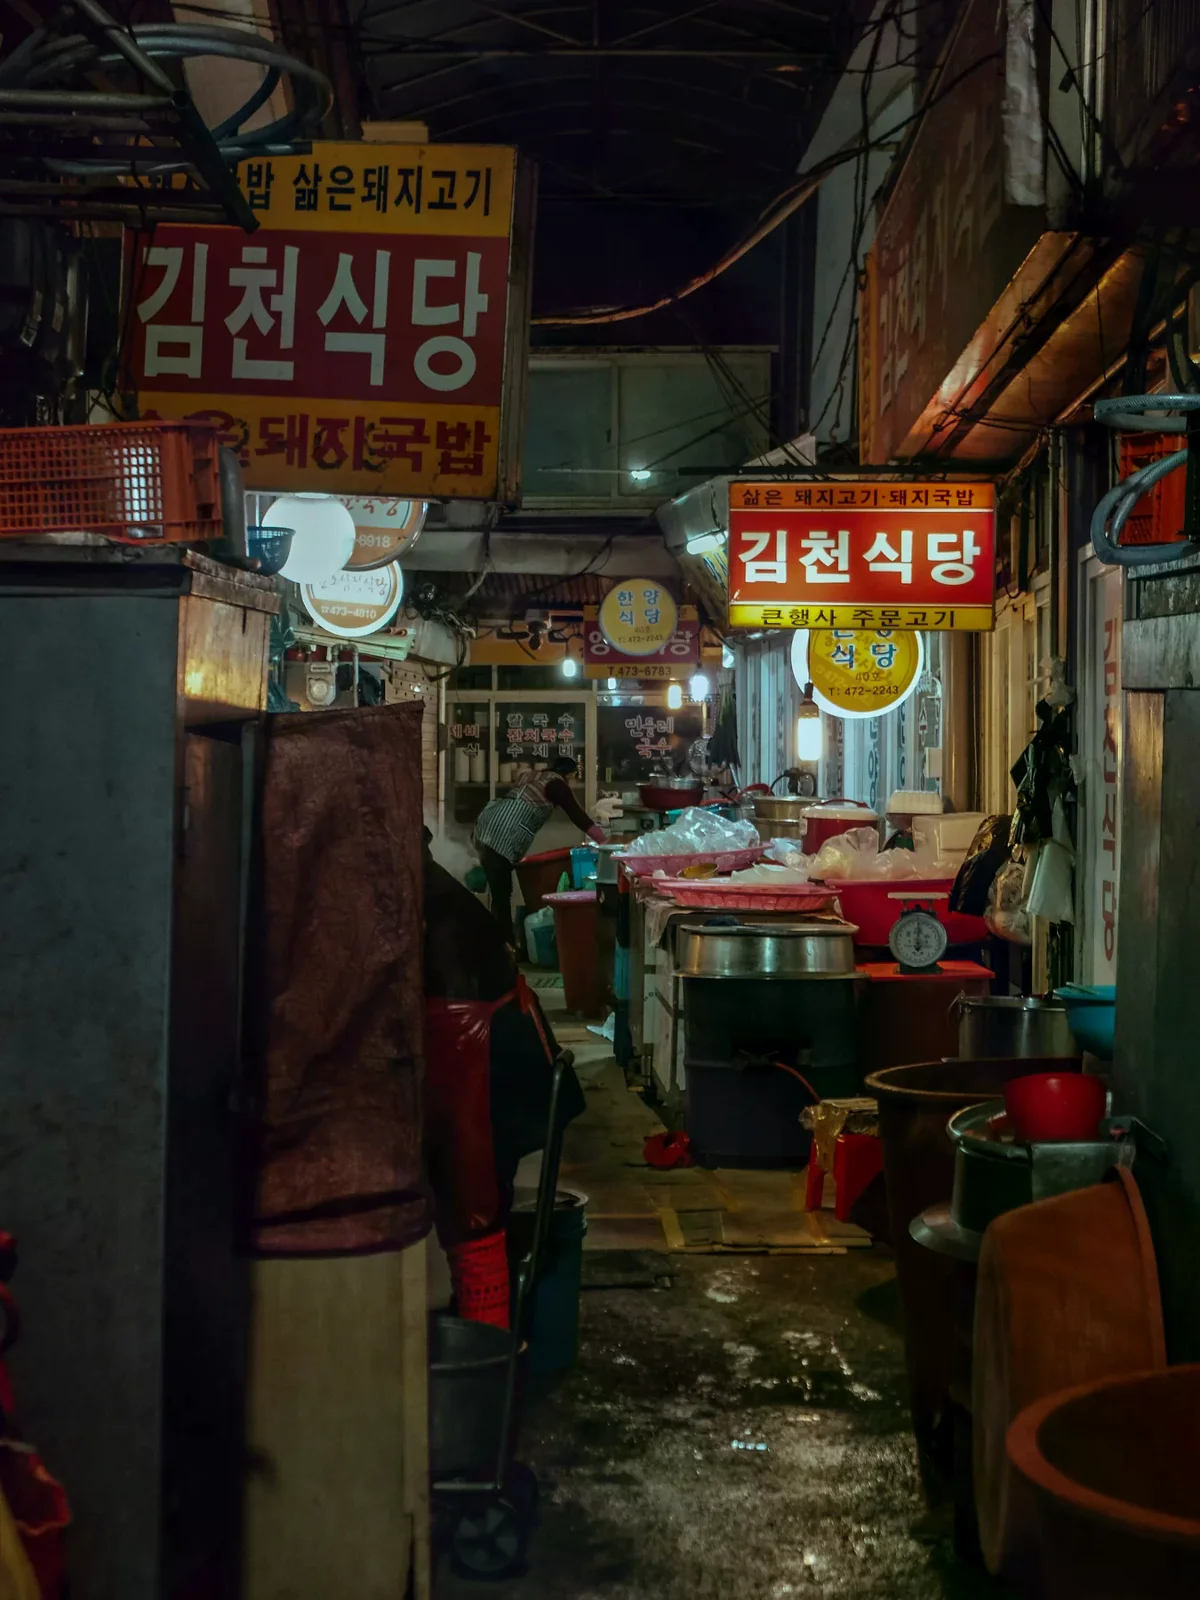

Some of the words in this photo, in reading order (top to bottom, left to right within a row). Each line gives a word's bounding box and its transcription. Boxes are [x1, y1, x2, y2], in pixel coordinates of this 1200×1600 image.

[238, 162, 275, 211] 밥
[293, 162, 492, 216] 삶은돼지고기
[137, 242, 489, 392] 김천식당
[742, 489, 784, 507] 삶은
[738, 529, 981, 585] 김천식당
[619, 608, 661, 626] 식당
[760, 608, 838, 627] 큰행사
[851, 609, 955, 628] 주문고기
[831, 643, 897, 668] 식당
[844, 685, 899, 696] 472-2243
[506, 712, 575, 728] 칼국수
[625, 714, 675, 738] 민들레
[506, 728, 575, 743] 잔치국수
[506, 743, 575, 758] 수제비
[635, 737, 672, 758] 국수
